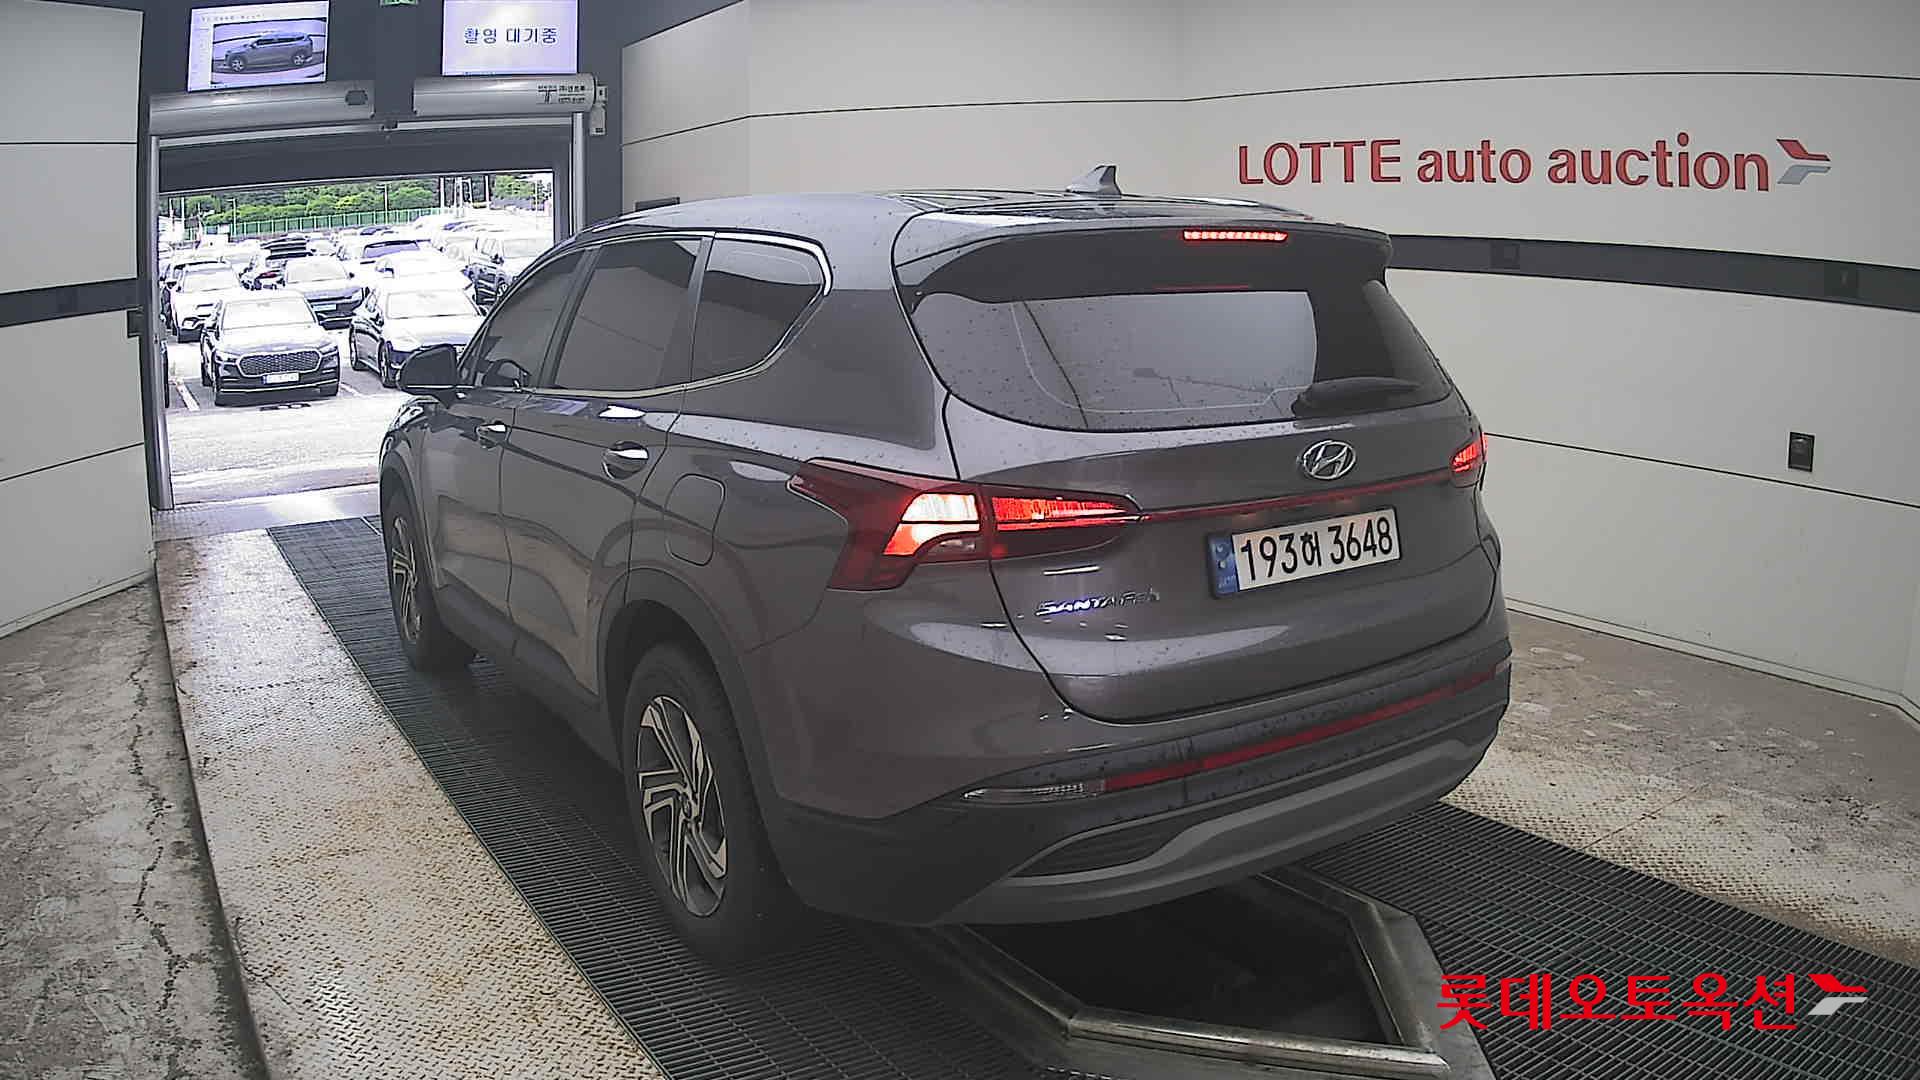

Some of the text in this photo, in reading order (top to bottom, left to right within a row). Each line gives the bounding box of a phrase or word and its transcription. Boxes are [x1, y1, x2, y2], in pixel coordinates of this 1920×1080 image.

[463, 26, 557, 45] 촬영 대기중
[1238, 131, 1771, 191] LOTTE auto auction
[1240, 516, 1393, 581] 193허 3648
